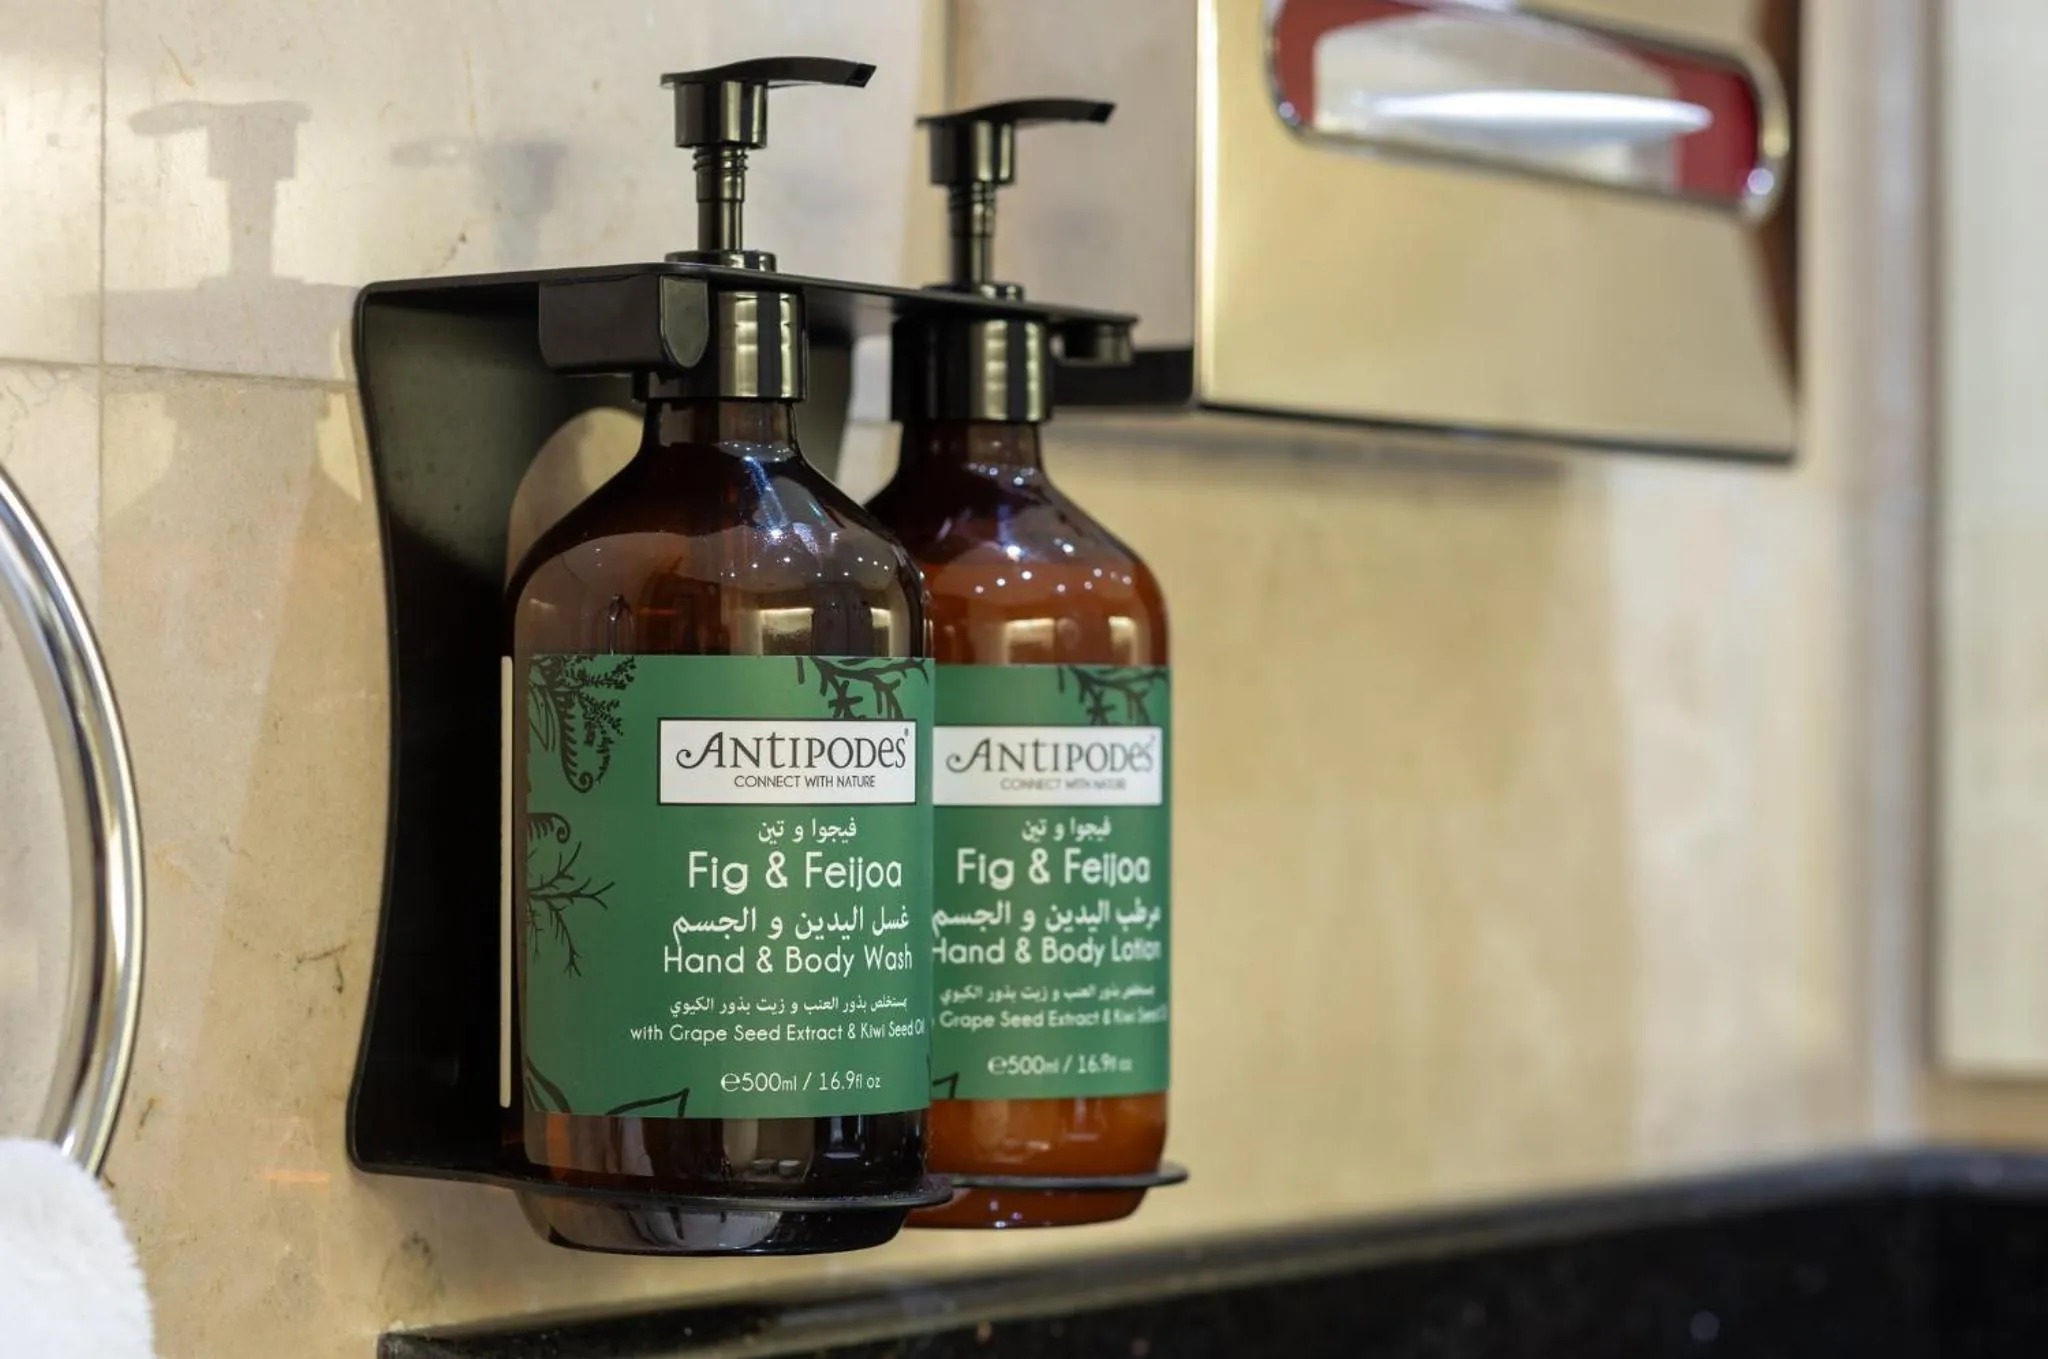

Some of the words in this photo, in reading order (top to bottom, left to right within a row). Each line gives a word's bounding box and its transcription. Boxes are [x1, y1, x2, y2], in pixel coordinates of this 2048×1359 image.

[735, 775, 800, 788] CONNECT
[805, 775, 834, 788] WITH
[837, 775, 875, 788] NATURE
[758, 820, 784, 845] تين
[791, 826, 804, 842] و
[812, 817, 857, 844] فيجوا
[1022, 818, 1047, 842] تين
[1053, 823, 1065, 841] و
[1070, 815, 1111, 841] فيجوا
[689, 851, 748, 895] Fig
[765, 851, 788, 888] &
[806, 851, 902, 892] Feijoa
[957, 848, 1014, 890] Fig
[1028, 848, 1050, 884] &
[1064, 848, 1150, 887] Feijoa
[673, 907, 756, 946] الجسم
[768, 915, 783, 939] و
[795, 906, 863, 940] اليدين
[872, 905, 909, 936] غسل
[1020, 908, 1036, 932] و
[1045, 899, 1110, 933] اليدين
[664, 946, 745, 973] Hand
[756, 946, 773, 973] &
[786, 945, 855, 977] Body
[864, 943, 912, 970] Wash
[1014, 937, 1032, 964] &
[1041, 936, 1105, 967] Body
[669, 997, 714, 1018] الكيوي
[719, 996, 751, 1015] بذور
[756, 998, 785, 1014] زيت
[790, 1002, 798, 1014] و
[630, 1025, 663, 1041] with
[669, 1024, 728, 1046] Grape
[733, 1024, 780, 1041] Seed
[787, 1023, 842, 1041] Extract
[846, 1024, 855, 1040] &
[861, 1022, 886, 1039] Kiwi
[889, 1020, 913, 1038] Seed
[939, 1010, 995, 1033] Grape
[999, 1010, 1044, 1028] Seed
[866, 1076, 881, 1089] oz
